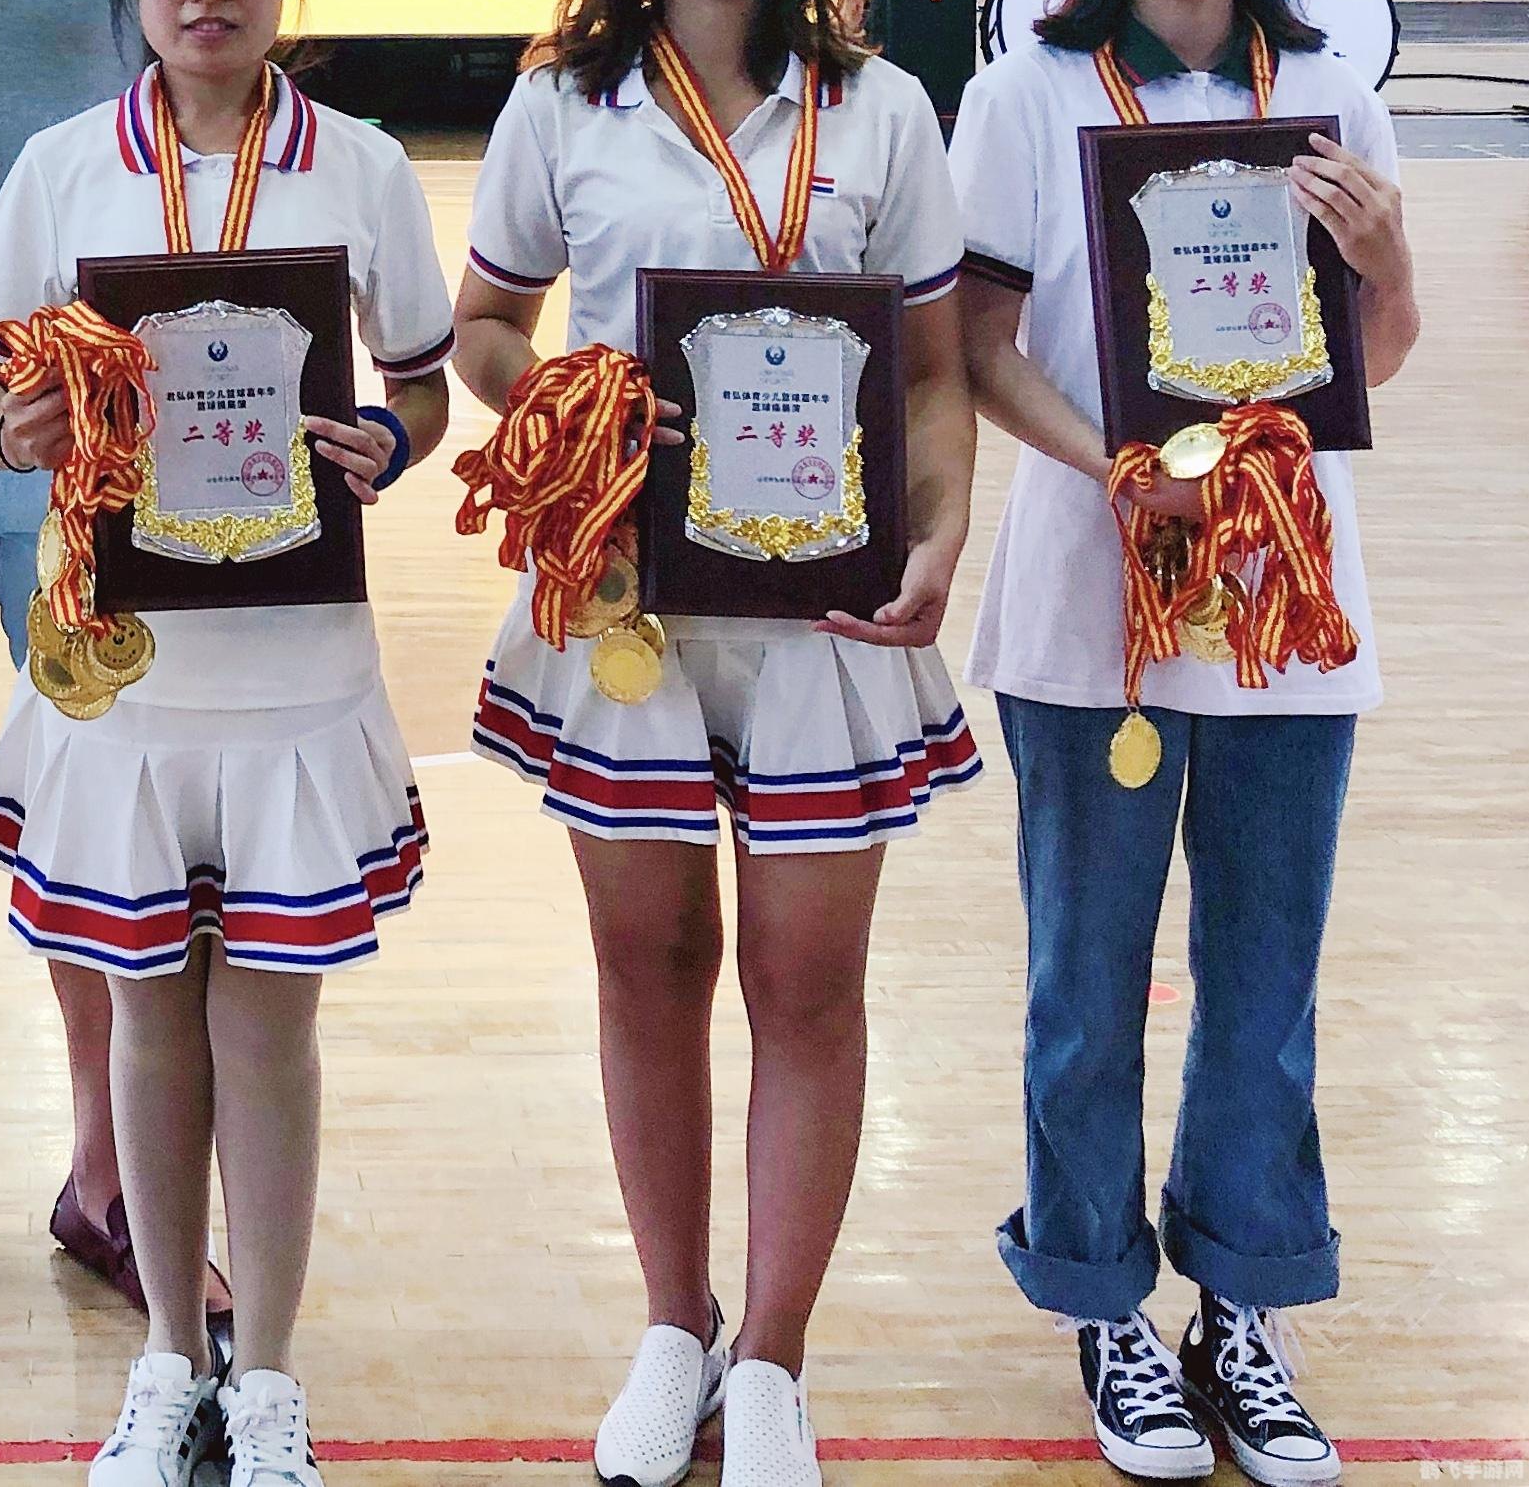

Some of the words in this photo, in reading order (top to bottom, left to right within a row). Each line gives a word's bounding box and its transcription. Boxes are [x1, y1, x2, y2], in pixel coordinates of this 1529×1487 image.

[1190, 271, 1272, 297] 二等奖
[182, 418, 265, 446] 二等奖
[735, 421, 818, 449] 二等奖
